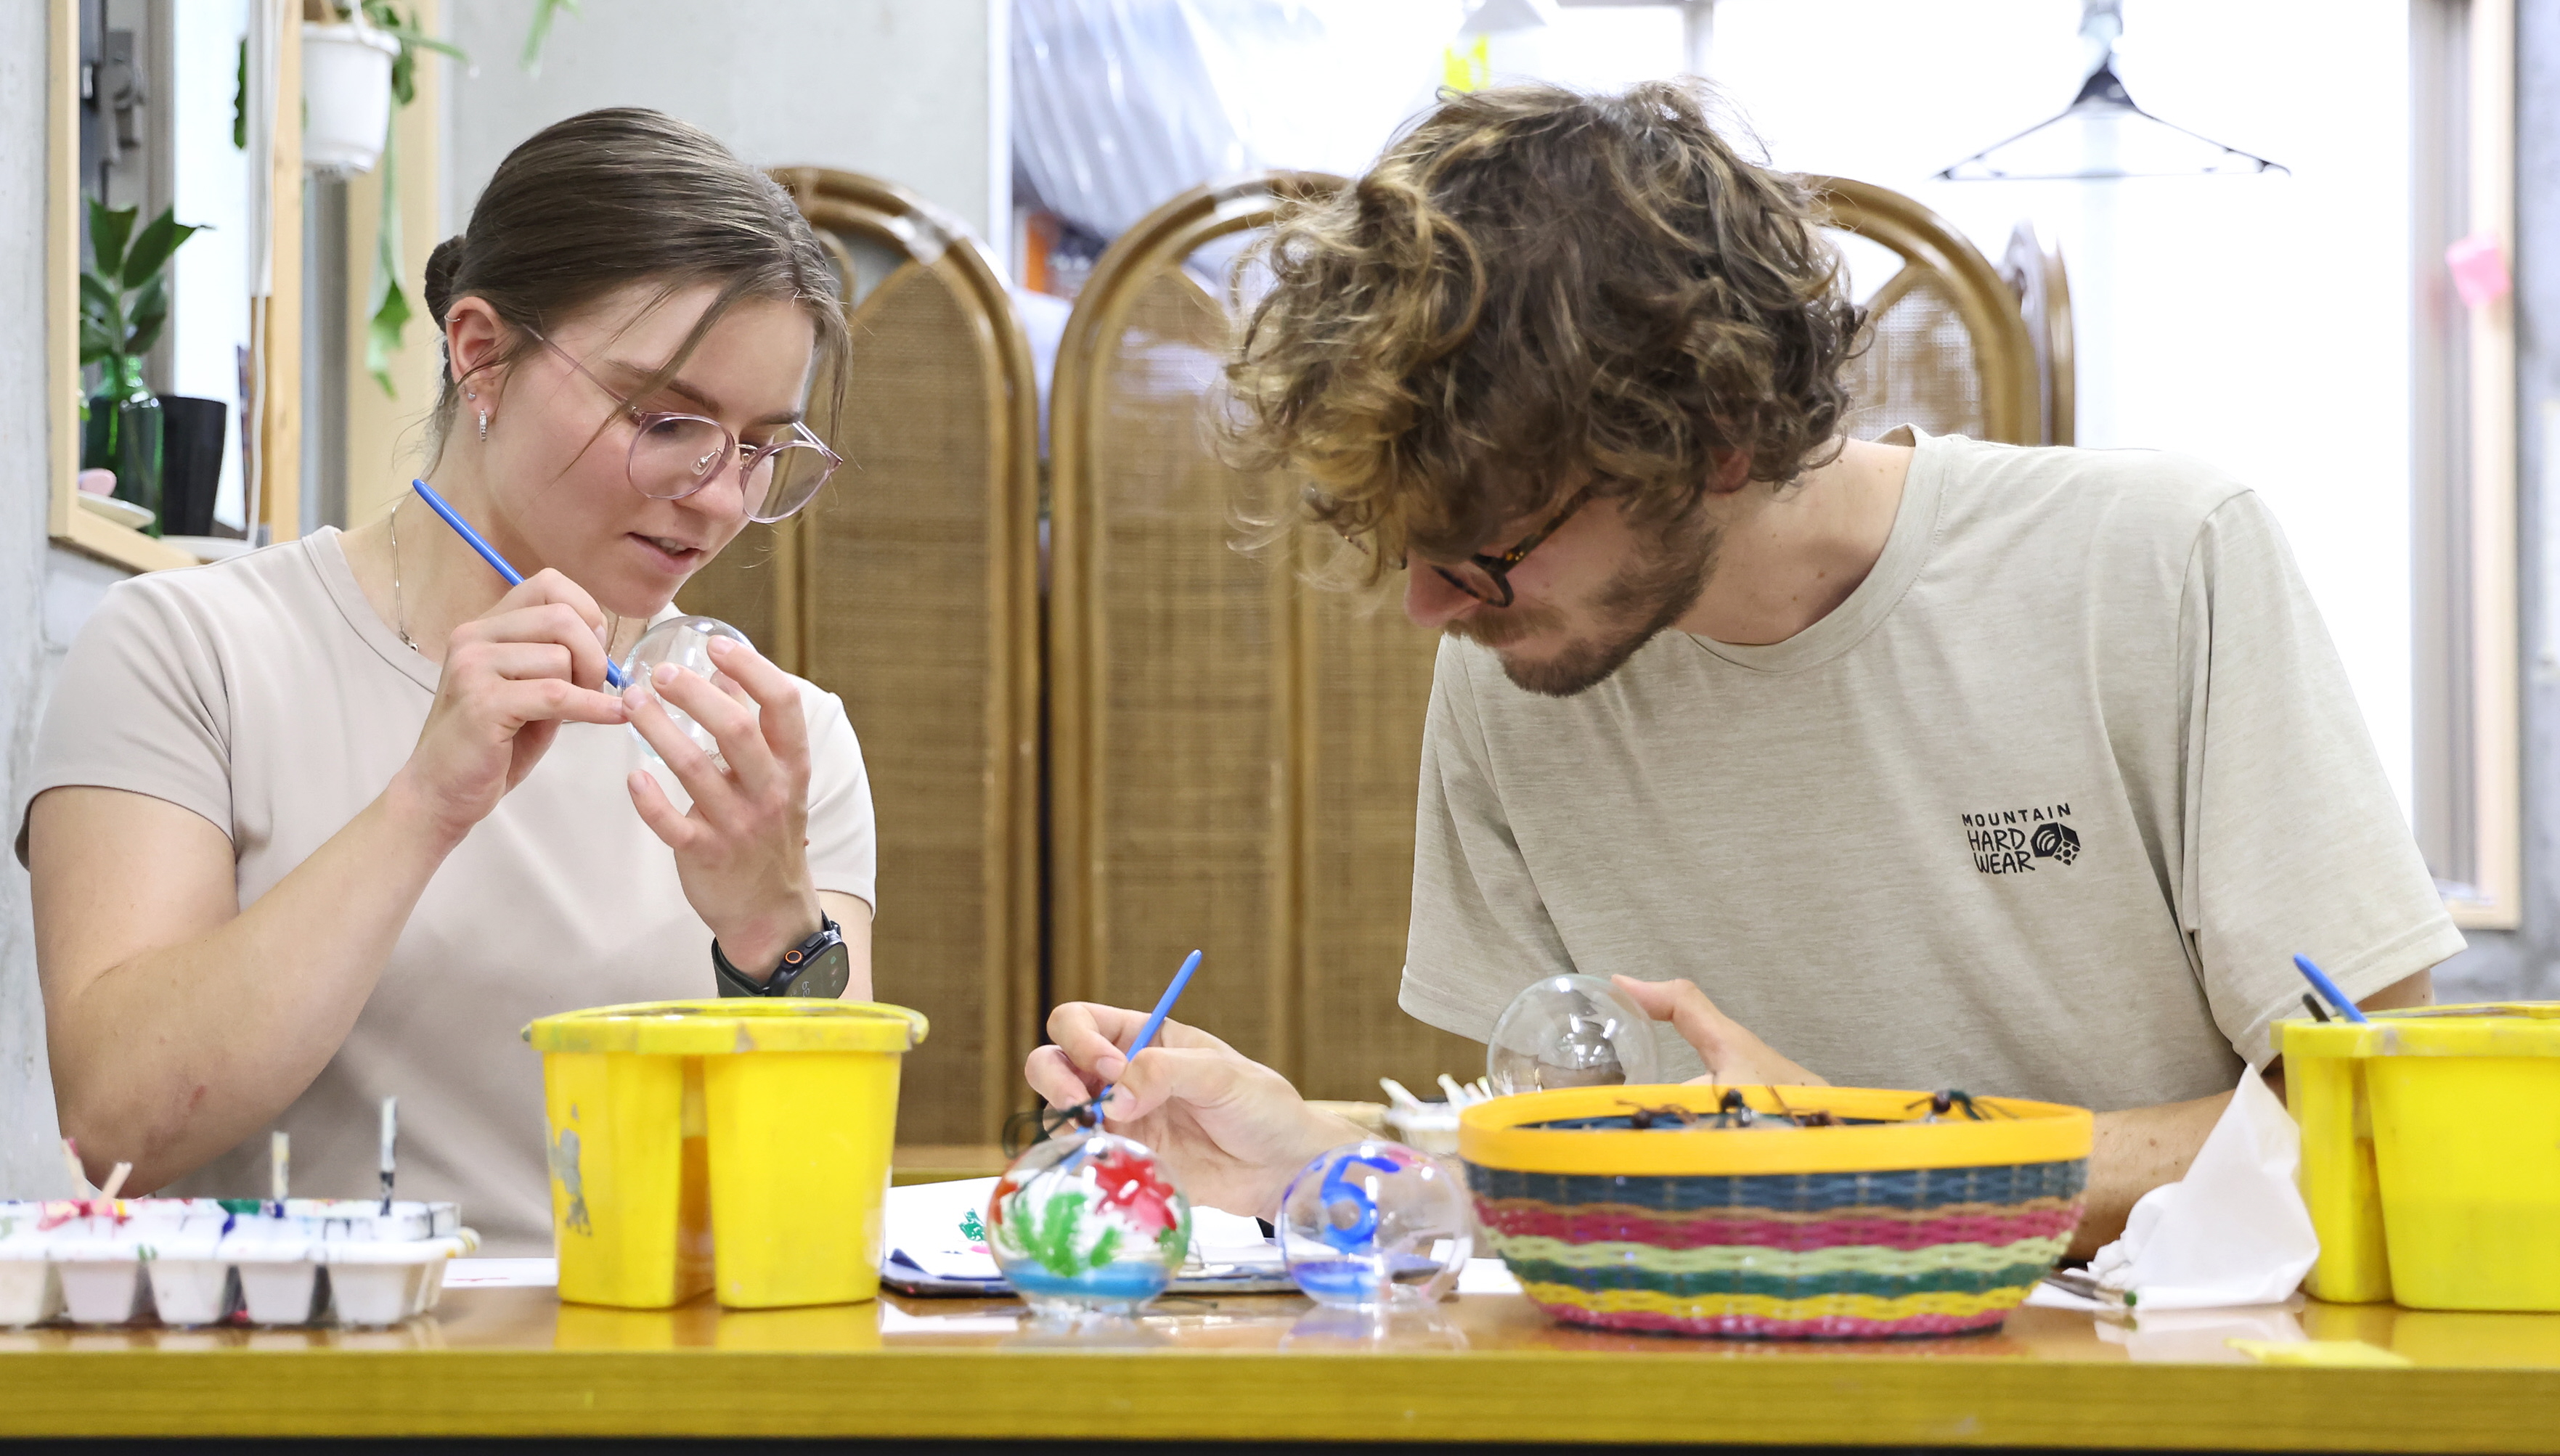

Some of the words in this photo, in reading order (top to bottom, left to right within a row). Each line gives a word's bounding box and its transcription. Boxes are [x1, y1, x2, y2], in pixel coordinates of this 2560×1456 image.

[1962, 803, 2071, 827] MOUNTAIN
[1967, 827, 2026, 852] HARD
[1973, 851, 2036, 875] WEAR
